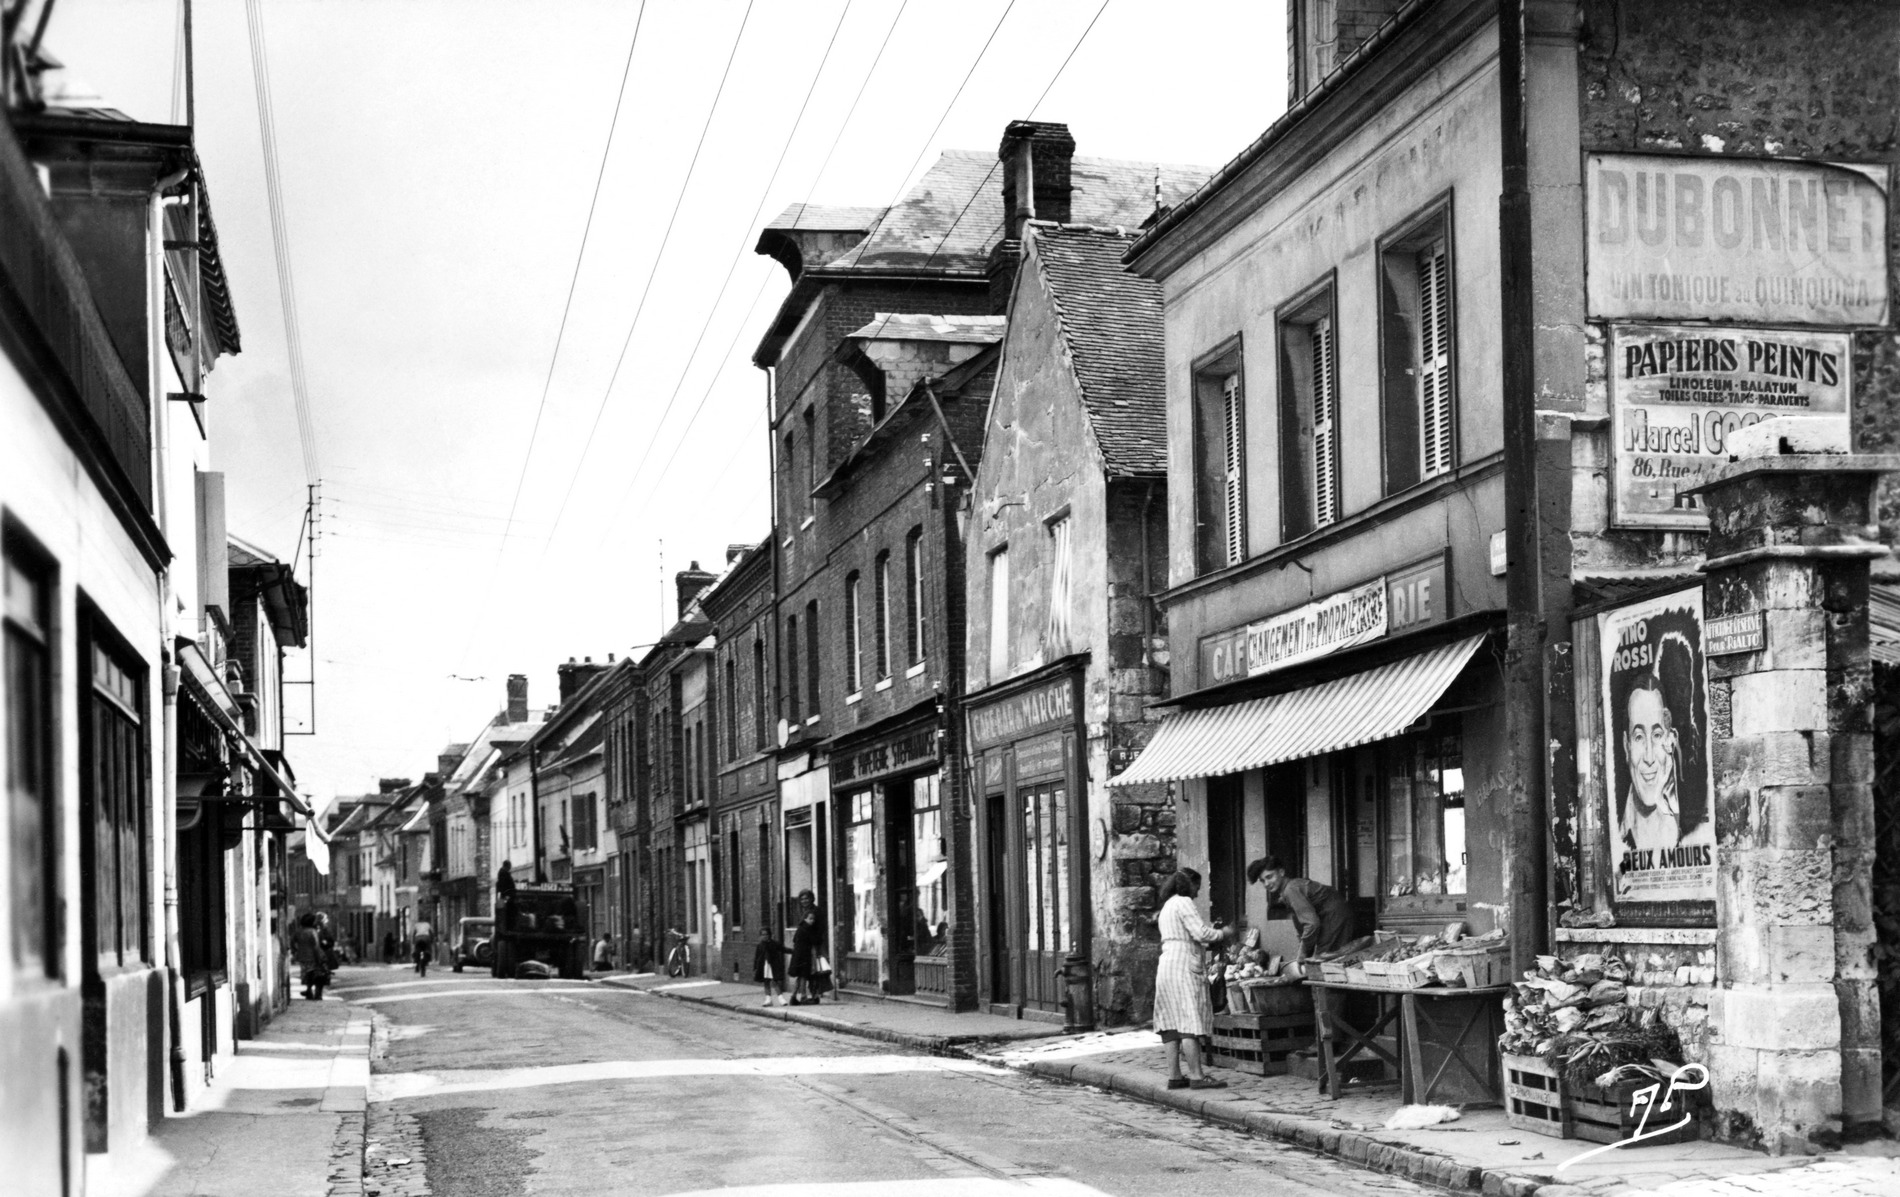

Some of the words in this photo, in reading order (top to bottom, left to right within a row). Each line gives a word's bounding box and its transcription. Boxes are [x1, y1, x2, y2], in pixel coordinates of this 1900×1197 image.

[1598, 168, 1876, 253] DUBONNET
[1648, 272, 1729, 304] TONIQUE
[1625, 338, 1738, 379] PAPIERS
[1748, 340, 1838, 387] PEINTS
[1658, 389, 1691, 402] TOILES
[1758, 393, 1810, 407] PARAVENTS
[1669, 377, 1733, 391] LINOLÉUM
[1740, 380, 1798, 394] BALATUM
[1622, 409, 1700, 454] Marcel
[1658, 458, 1691, 478] Rue
[1248, 617, 1306, 670] CHANGEMENT
[1617, 620, 1648, 647] TINO
[1612, 643, 1654, 673] ROSSI
[1659, 845, 1712, 869] AMOURS
